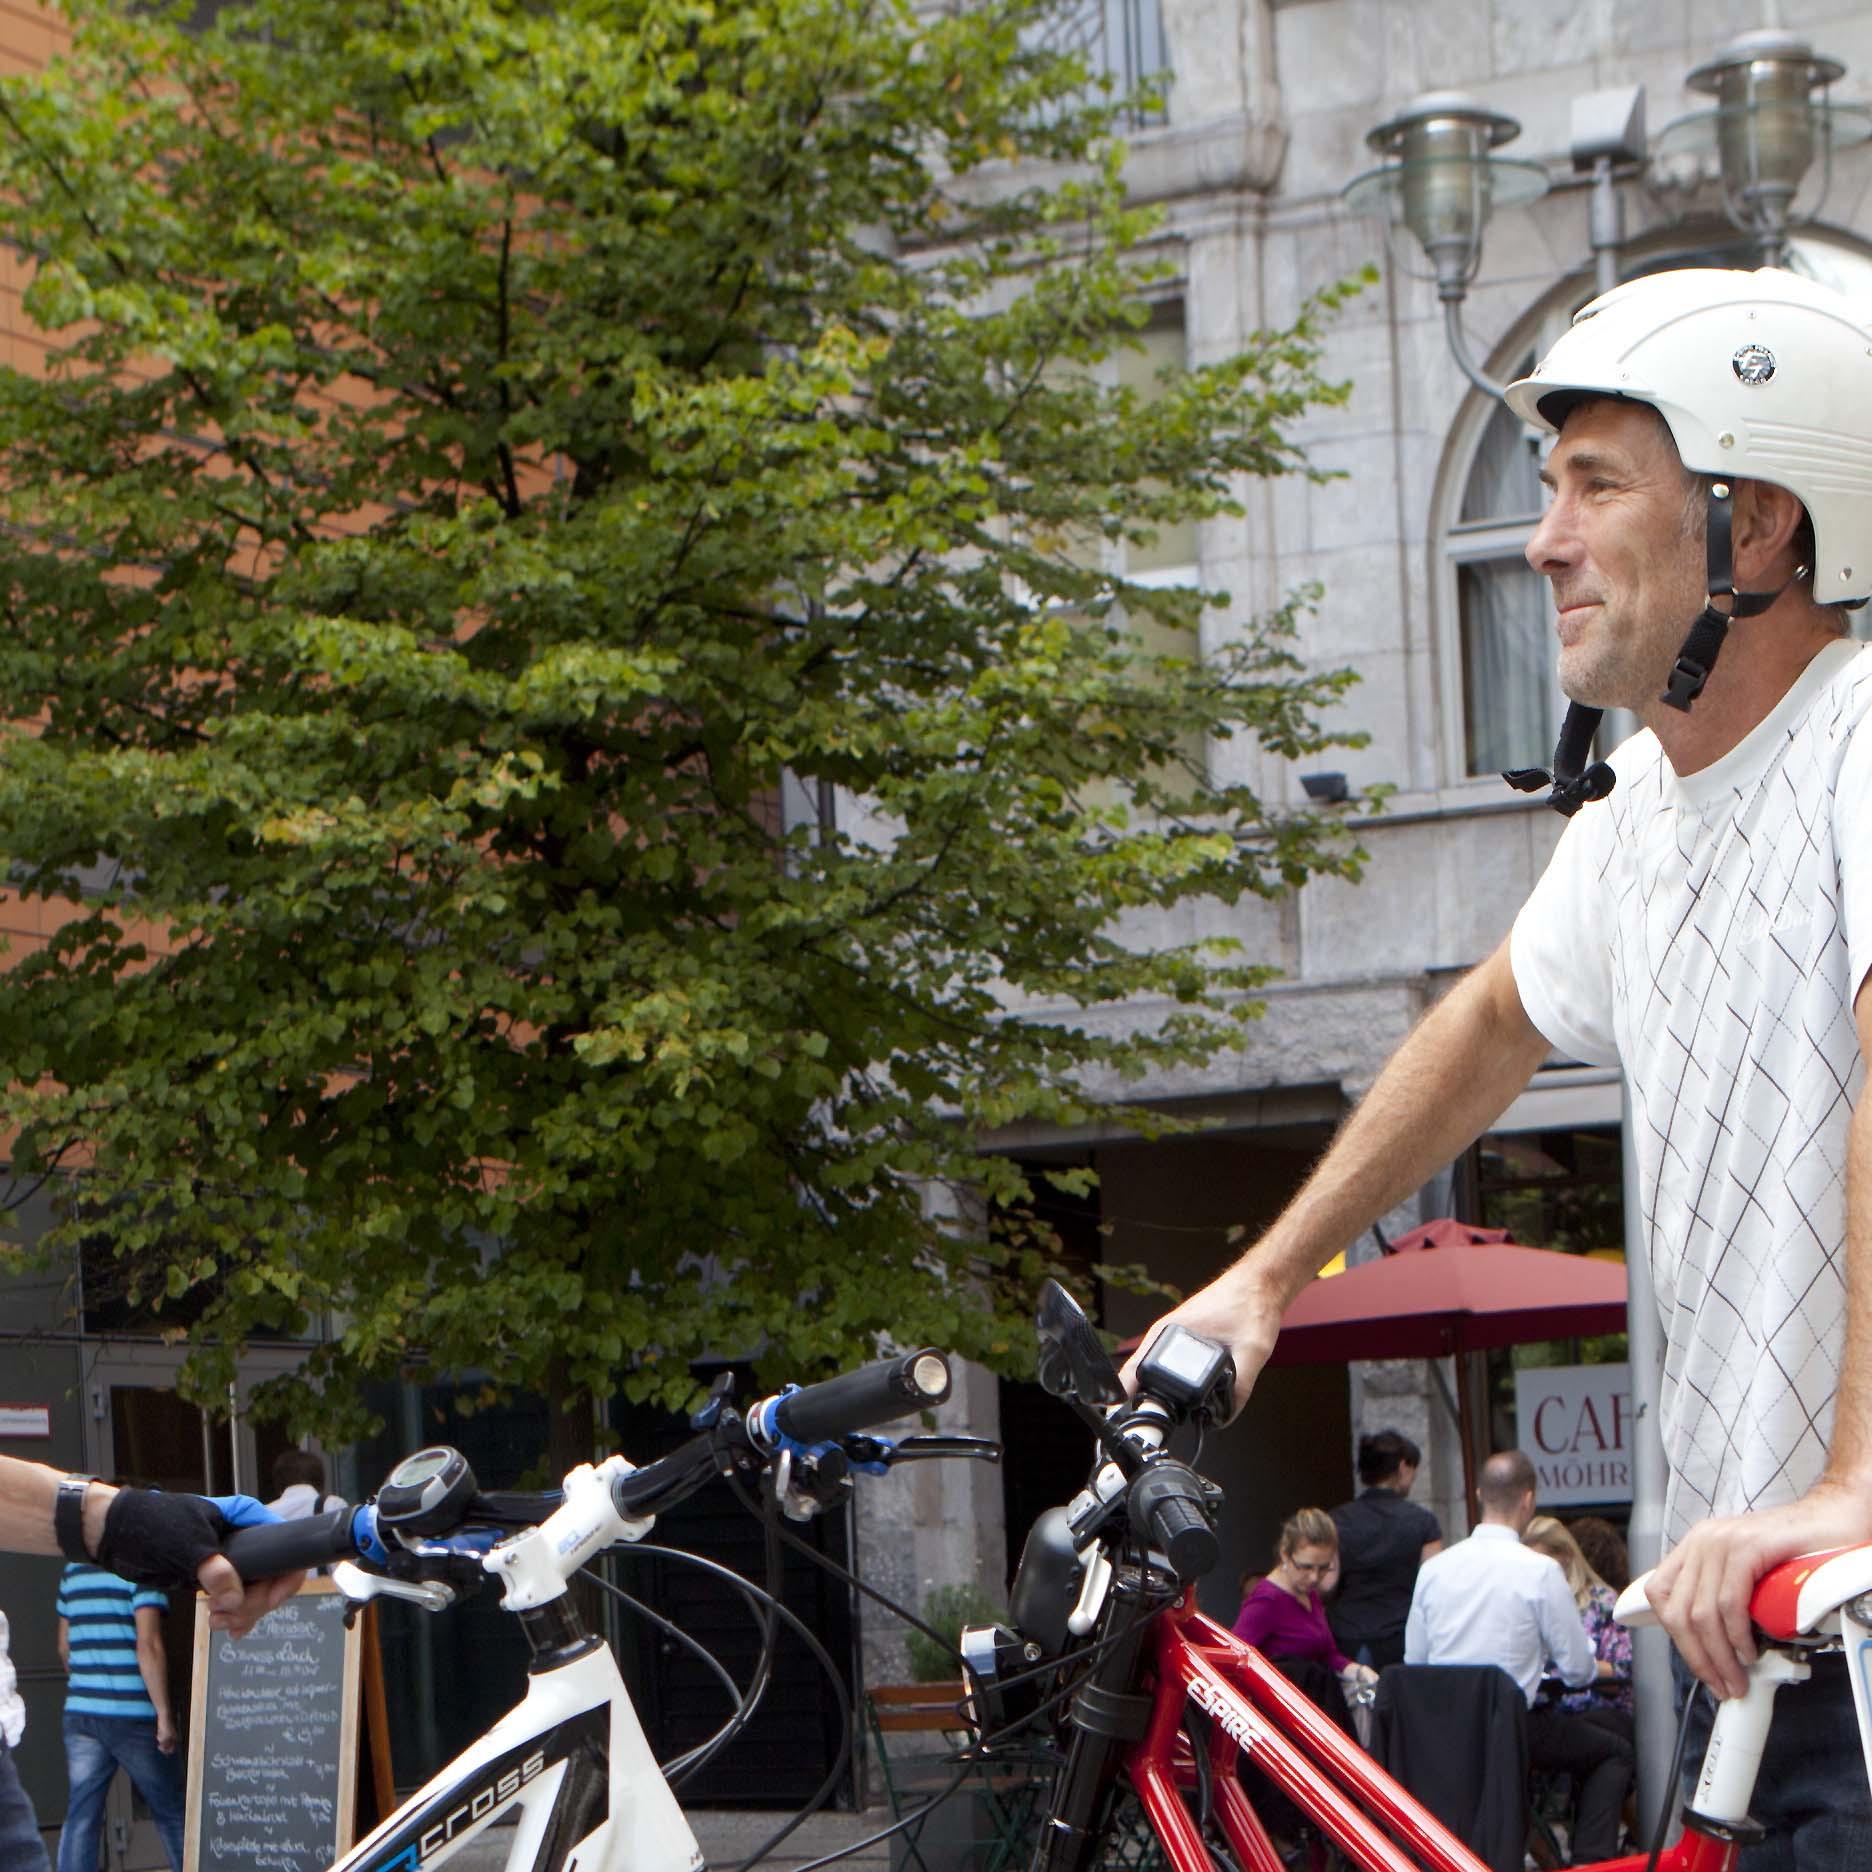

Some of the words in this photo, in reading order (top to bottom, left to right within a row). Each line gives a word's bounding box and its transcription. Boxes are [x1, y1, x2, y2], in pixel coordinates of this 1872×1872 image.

[1534, 1392, 1632, 1455] CAF
[1537, 1459, 1630, 1489] MÖHR
[1186, 1676, 1262, 1755] ESPIRE
